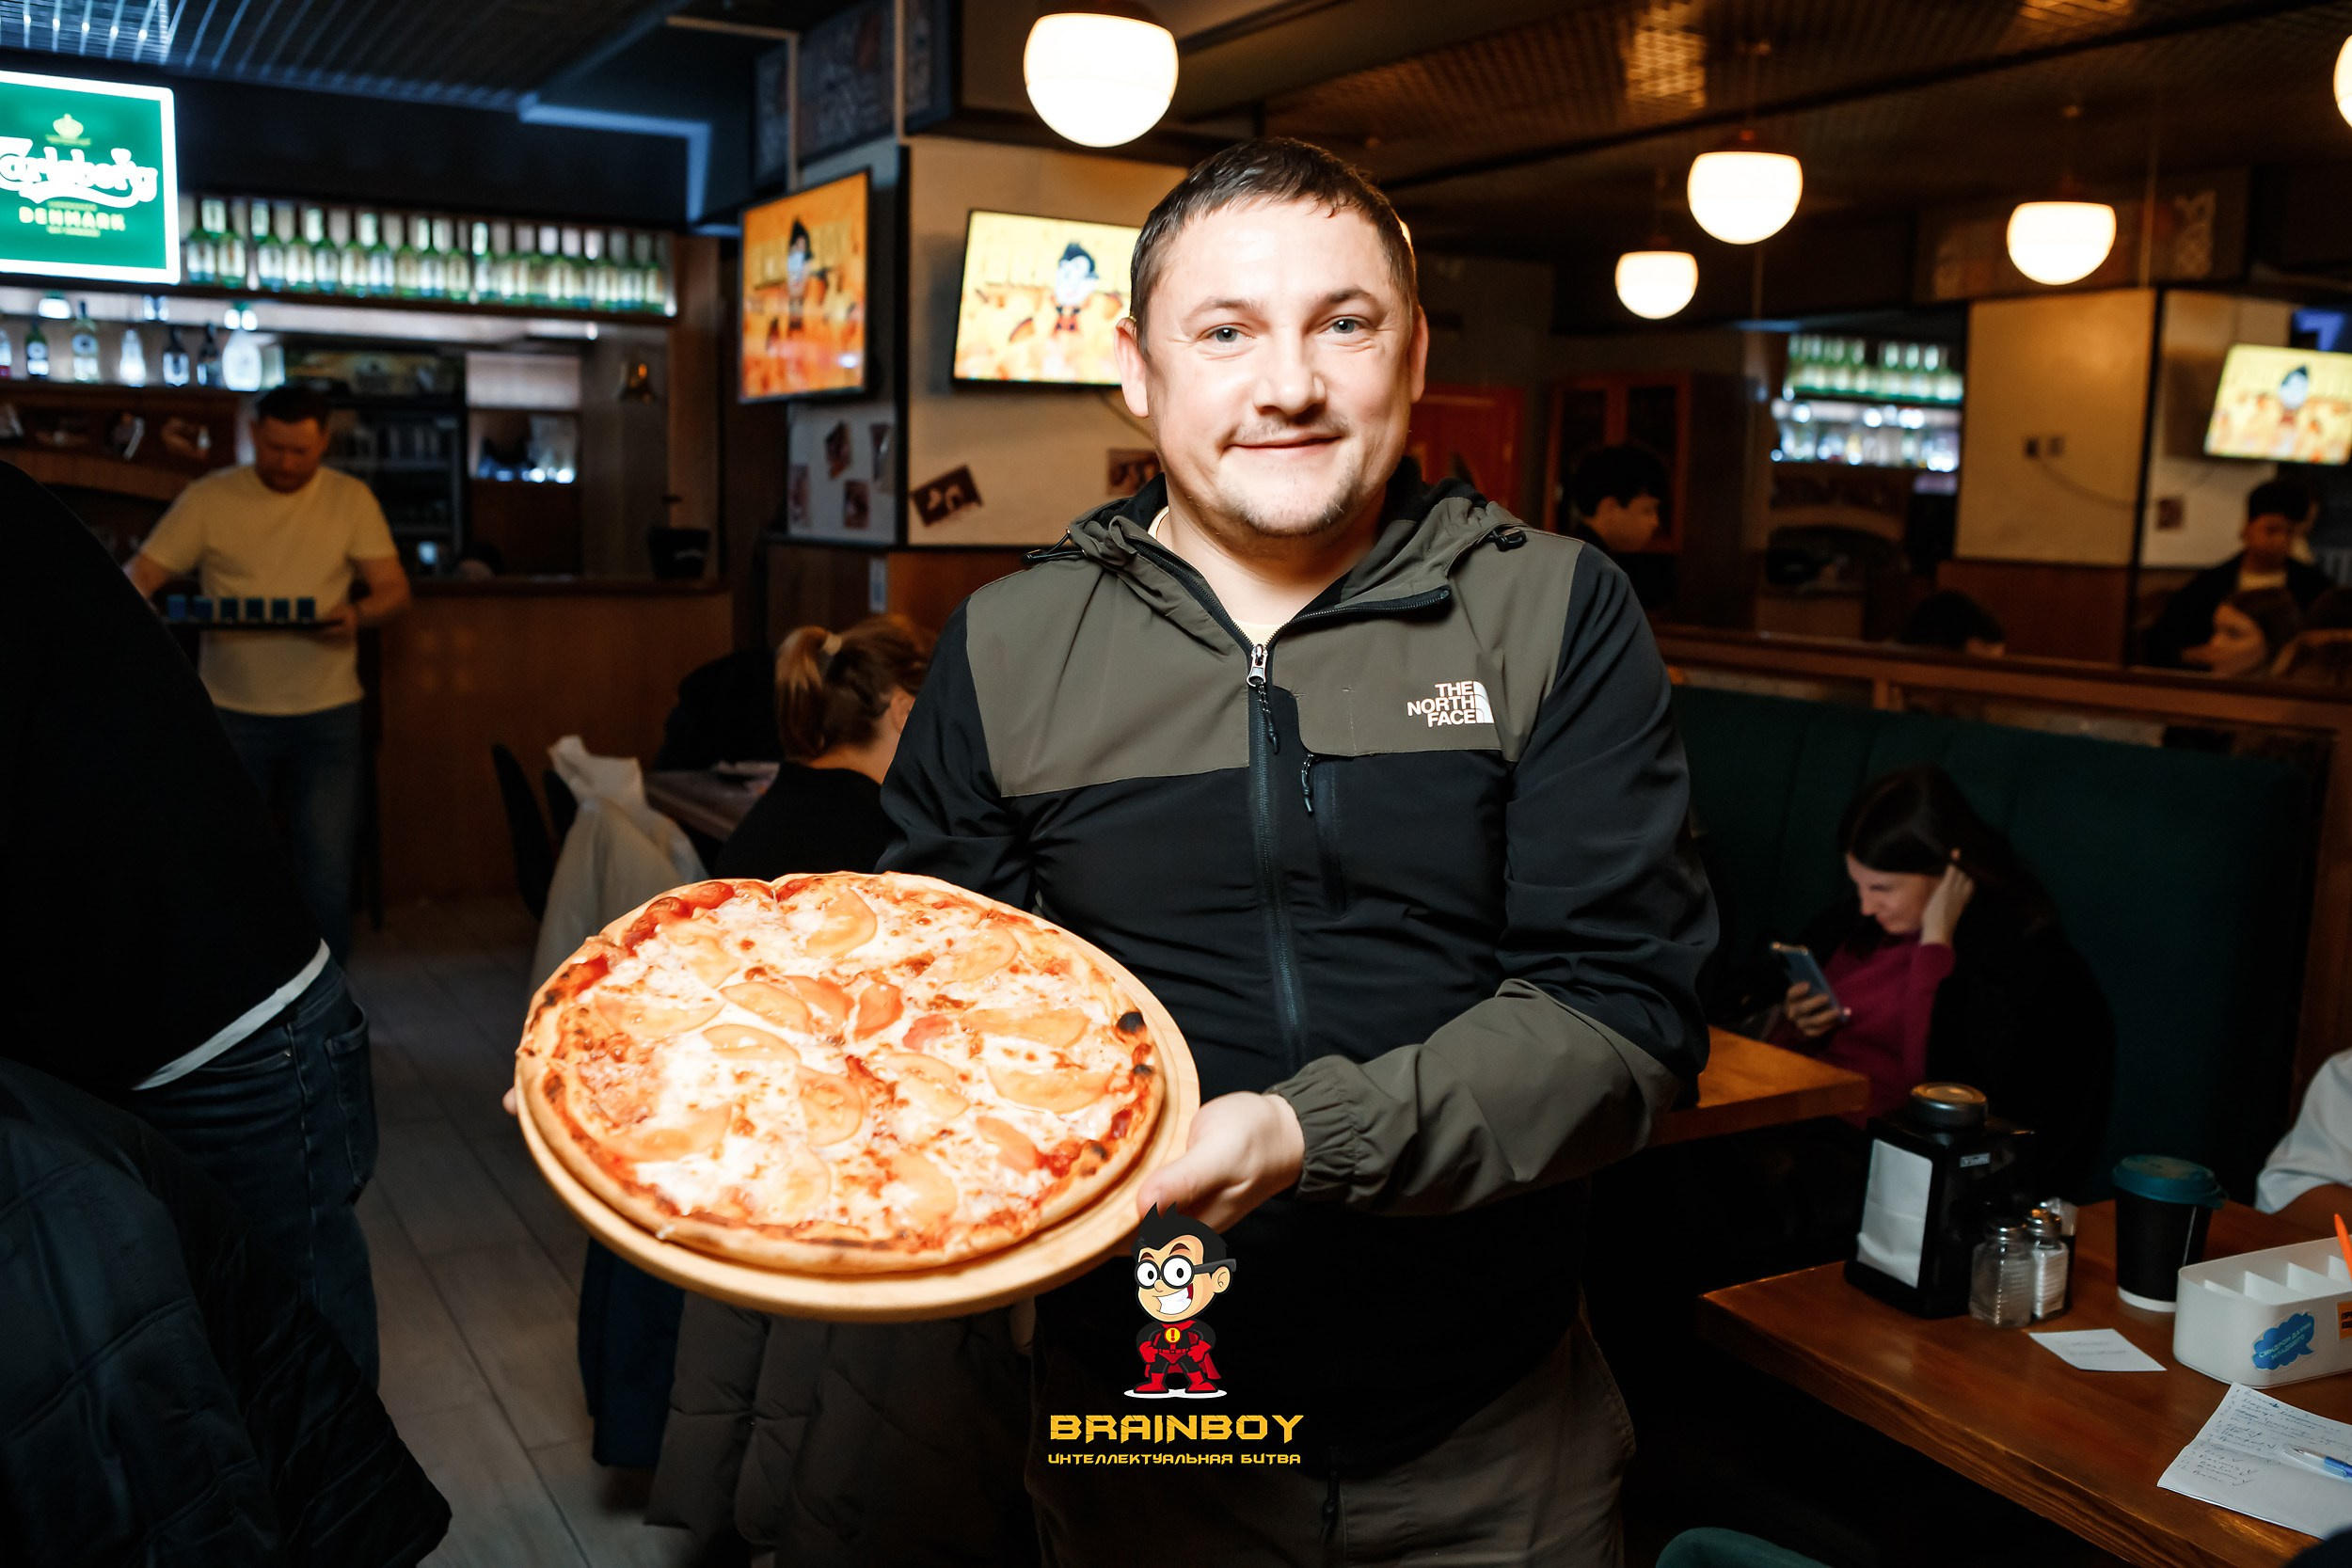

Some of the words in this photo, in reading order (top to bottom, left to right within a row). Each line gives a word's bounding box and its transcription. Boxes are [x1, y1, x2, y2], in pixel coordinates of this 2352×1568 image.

[19, 206, 126, 231] DENMARK
[1435, 680, 1474, 698] THE
[1406, 695, 1475, 717] NORTH
[1427, 709, 1477, 728] FACE
